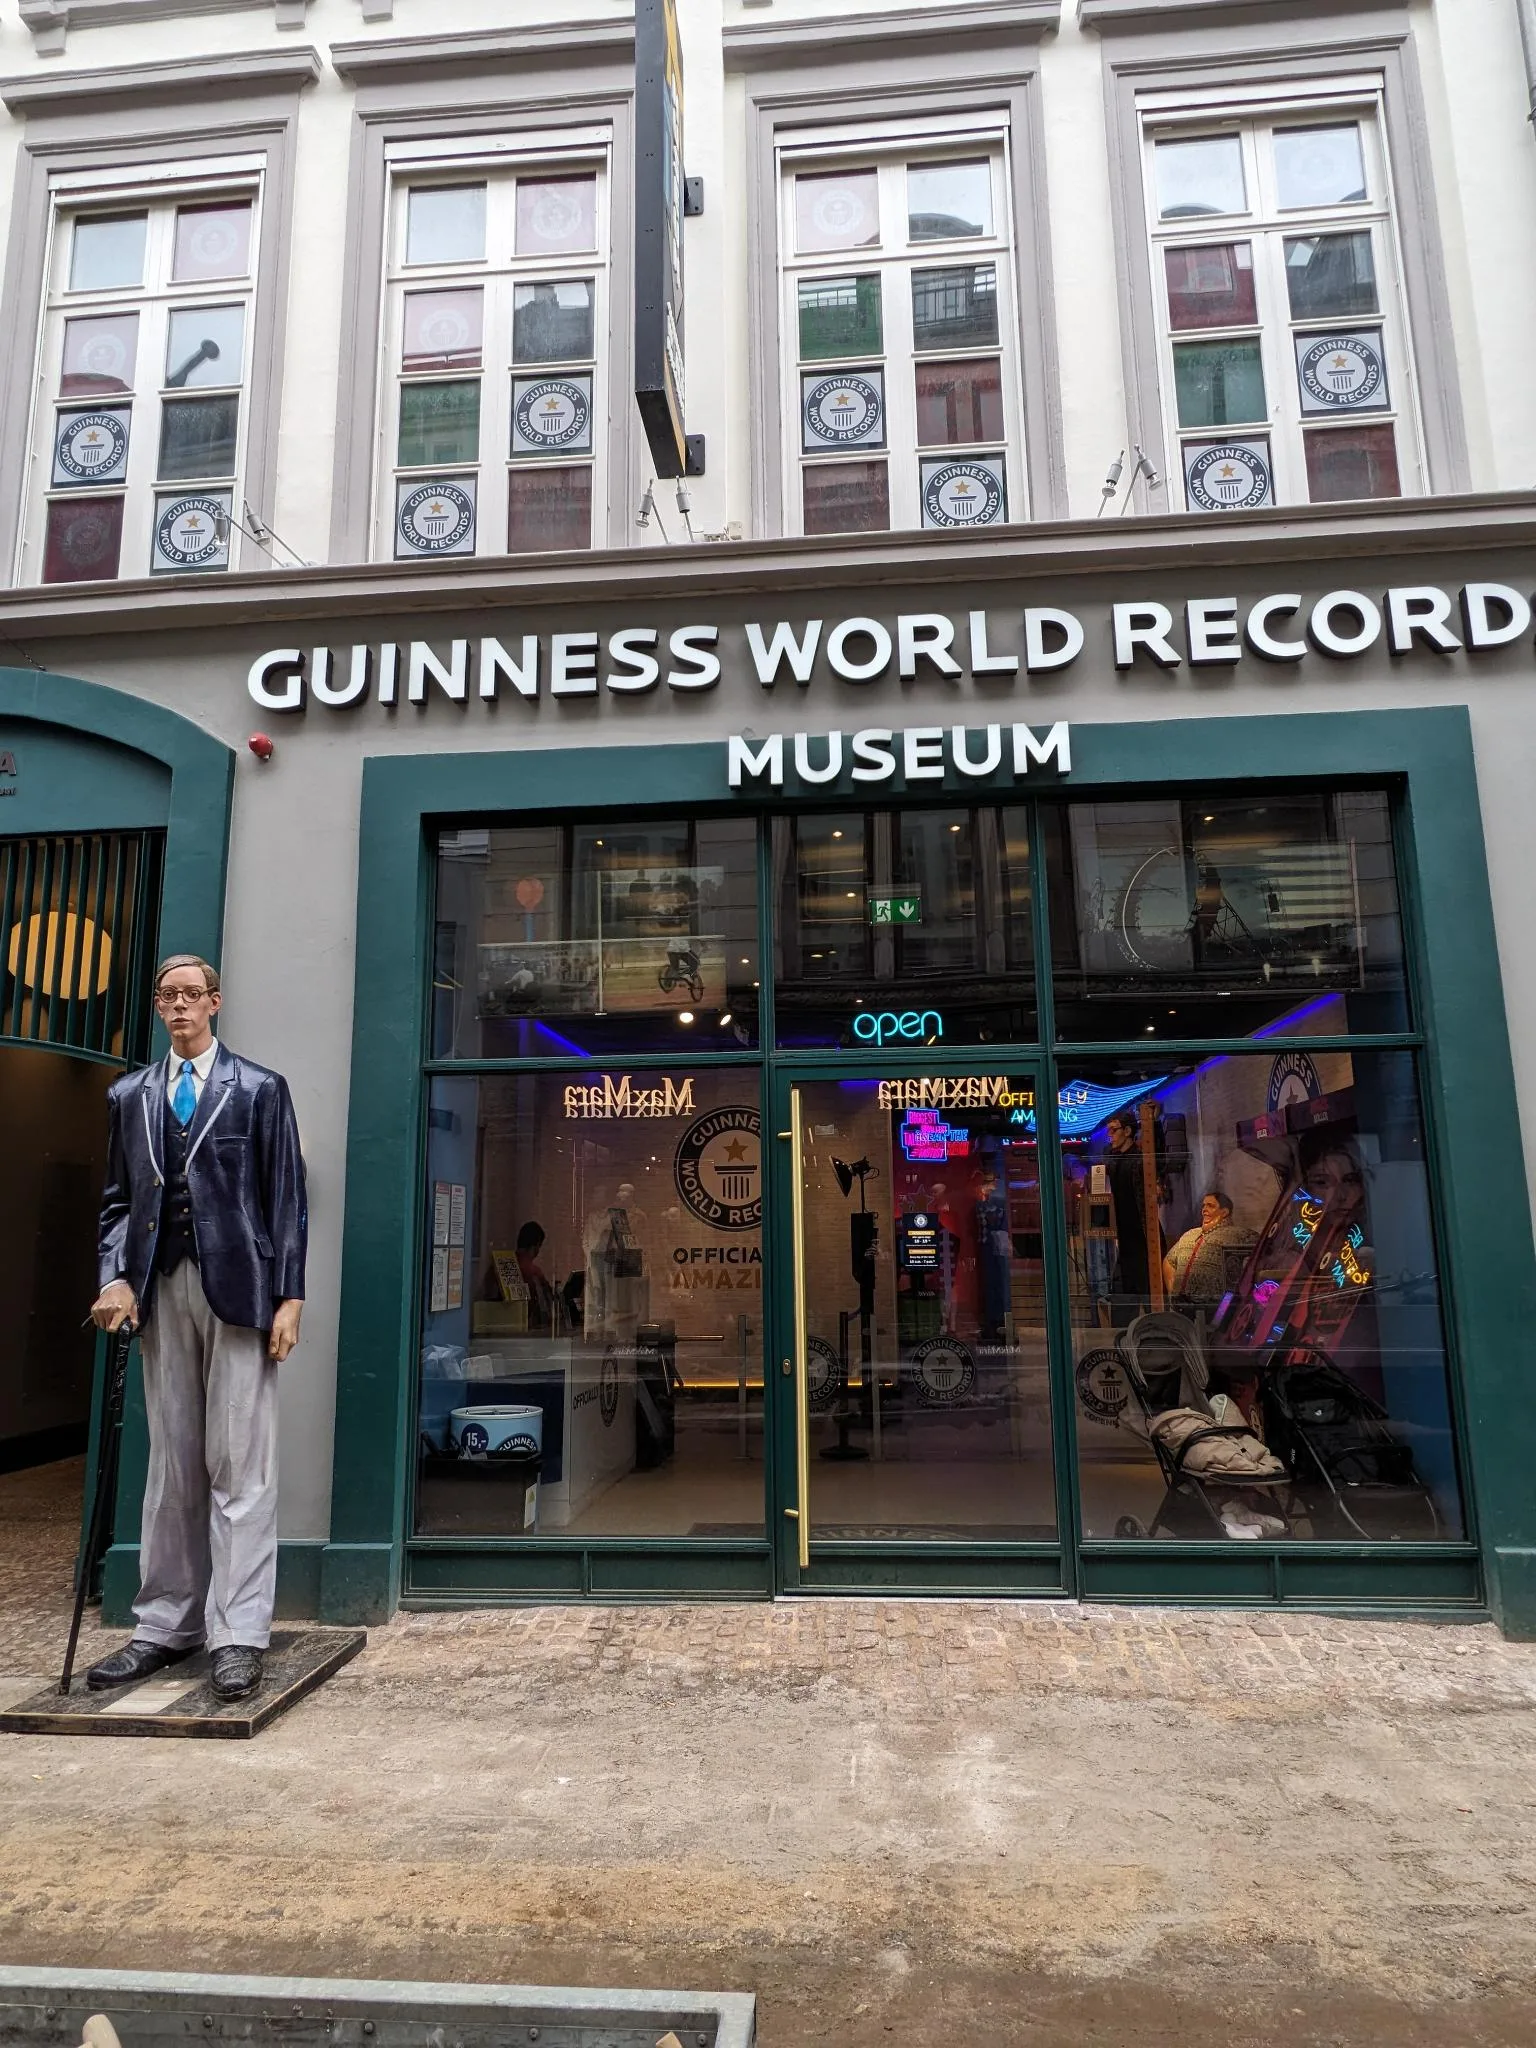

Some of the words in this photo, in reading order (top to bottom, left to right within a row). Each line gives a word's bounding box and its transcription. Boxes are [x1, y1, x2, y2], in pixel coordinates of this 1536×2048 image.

[1310, 340, 1369, 362] GUINNESS
[525, 384, 580, 405] GUINNESS
[815, 379, 871, 399] GUINNESS
[1304, 370, 1334, 402] WORLD
[1339, 364, 1377, 403] RECORDS
[68, 416, 120, 437] GUINNESS
[518, 411, 543, 443] WORLD
[547, 407, 585, 445] RECORDS
[809, 407, 834, 438] WORLD
[839, 402, 877, 440] RECORDS
[60, 444, 83, 475] WORLD
[85, 439, 124, 476] RECORDS
[1197, 450, 1258, 470] GUINNESS
[934, 466, 992, 488] GUINNESS
[1192, 477, 1222, 510] WORLD
[410, 486, 465, 508] GUINNESS
[928, 494, 955, 527] WORLD
[161, 528, 183, 560] WORLD
[186, 540, 217, 562] RECO
[403, 514, 427, 548] WORLD
[430, 511, 470, 549] RECORDS
[247, 625, 721, 712] GUINNESS
[745, 607, 1085, 688] WORLD
[1111, 582, 1536, 671] RECORD
[728, 720, 1072, 790] MUSEUM
[853, 1010, 943, 1046] open
[1271, 1053, 1313, 1101] GUINNESS
[999, 1090, 1088, 1108] OFFILLY
[691, 1113, 762, 1147] GUINNE
[682, 1161, 722, 1219] WORLD
[673, 1247, 762, 1265] OFFICIA
[672, 1268, 761, 1290] AMAZI
[918, 1337, 967, 1359] GUINNESS
[1085, 1351, 1121, 1370] GUINNE
[808, 1365, 838, 1401] ECORDS
[466, 1431, 488, 1449] 15,-
